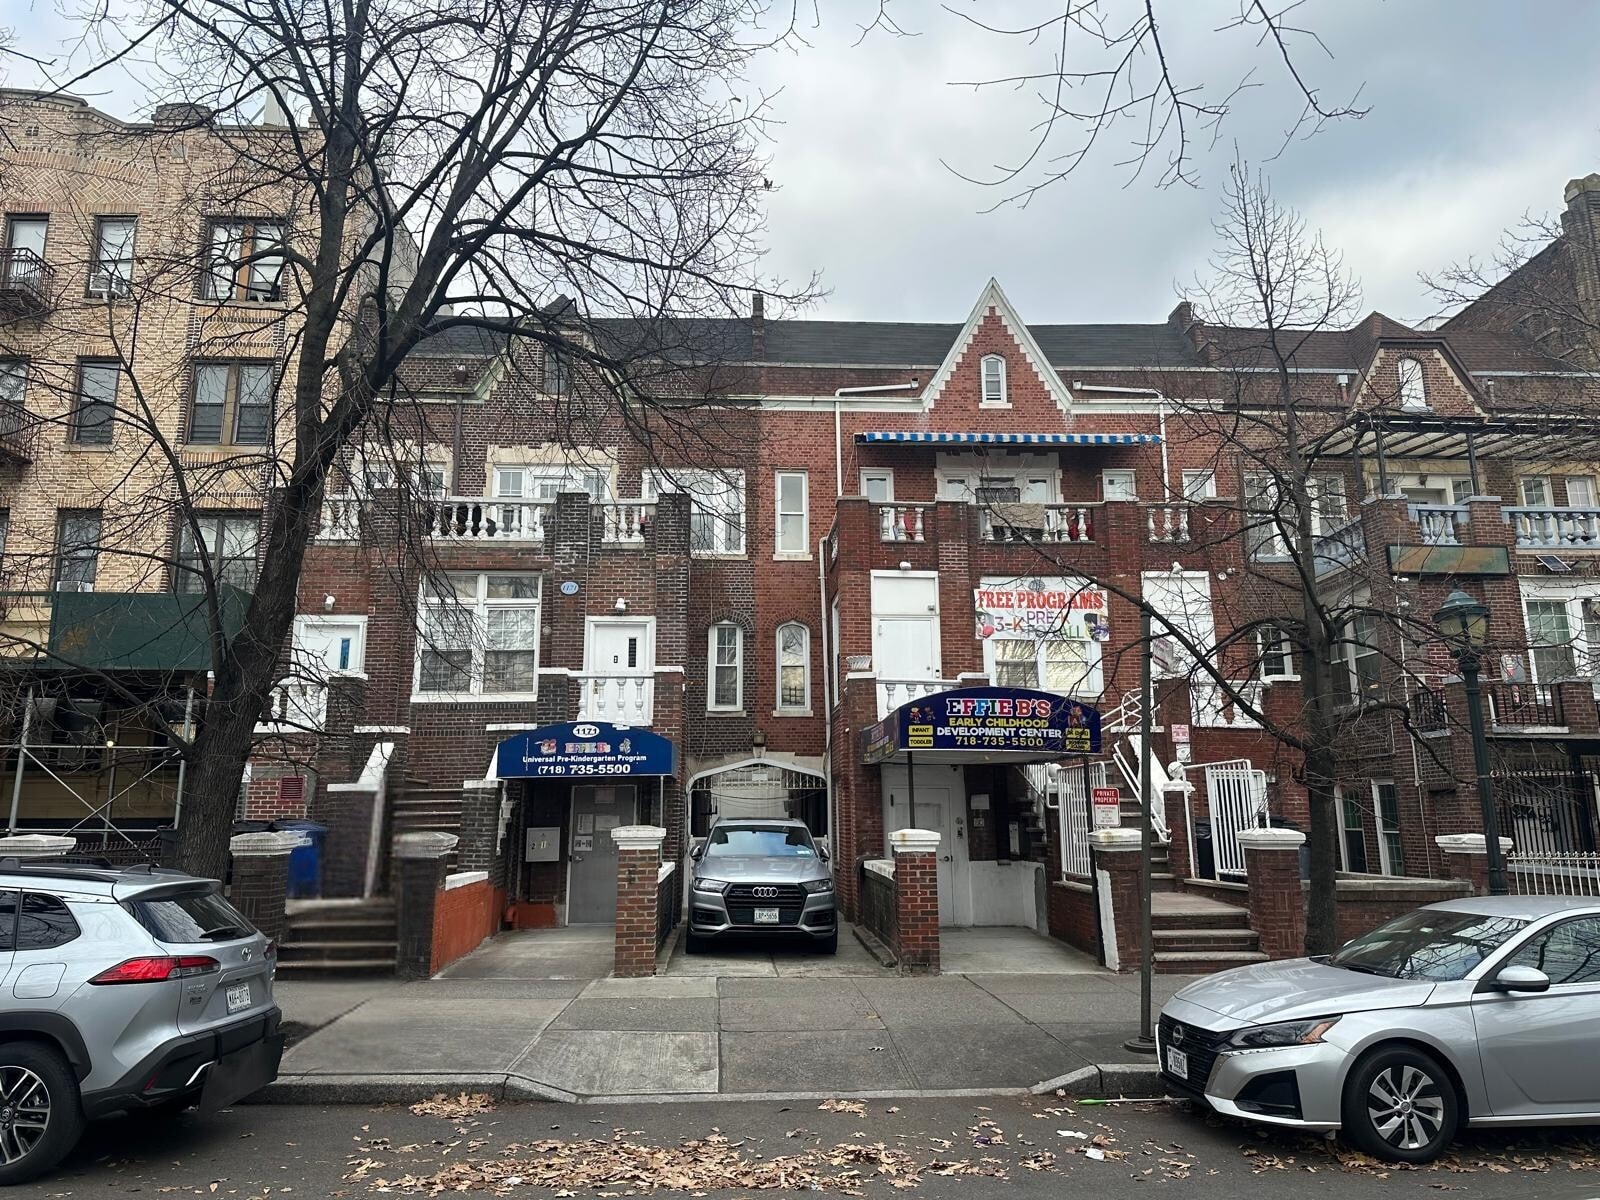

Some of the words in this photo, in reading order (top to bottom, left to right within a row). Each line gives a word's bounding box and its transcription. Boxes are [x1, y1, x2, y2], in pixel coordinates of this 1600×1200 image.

[978, 591, 1015, 609] FREE
[1018, 591, 1104, 610] PROGRAMS
[1026, 610, 1070, 625] PRE-K
[994, 616, 1025, 632] 3-K
[946, 698, 1013, 717] EFFIE
[1016, 699, 1051, 718] B'S
[949, 718, 984, 727] EARLY
[986, 718, 1049, 728] CHILDHOOD
[937, 727, 1017, 737] DEVELOPMENT
[1019, 727, 1062, 738] CENTER
[955, 737, 1044, 747] 718-735-5500
[522, 755, 556, 763] Universal
[556, 755, 616, 764] Pre-Kindergarten
[617, 754, 647, 764] Program
[537, 765, 566, 775] (718)
[570, 764, 631, 774] 735-5500
